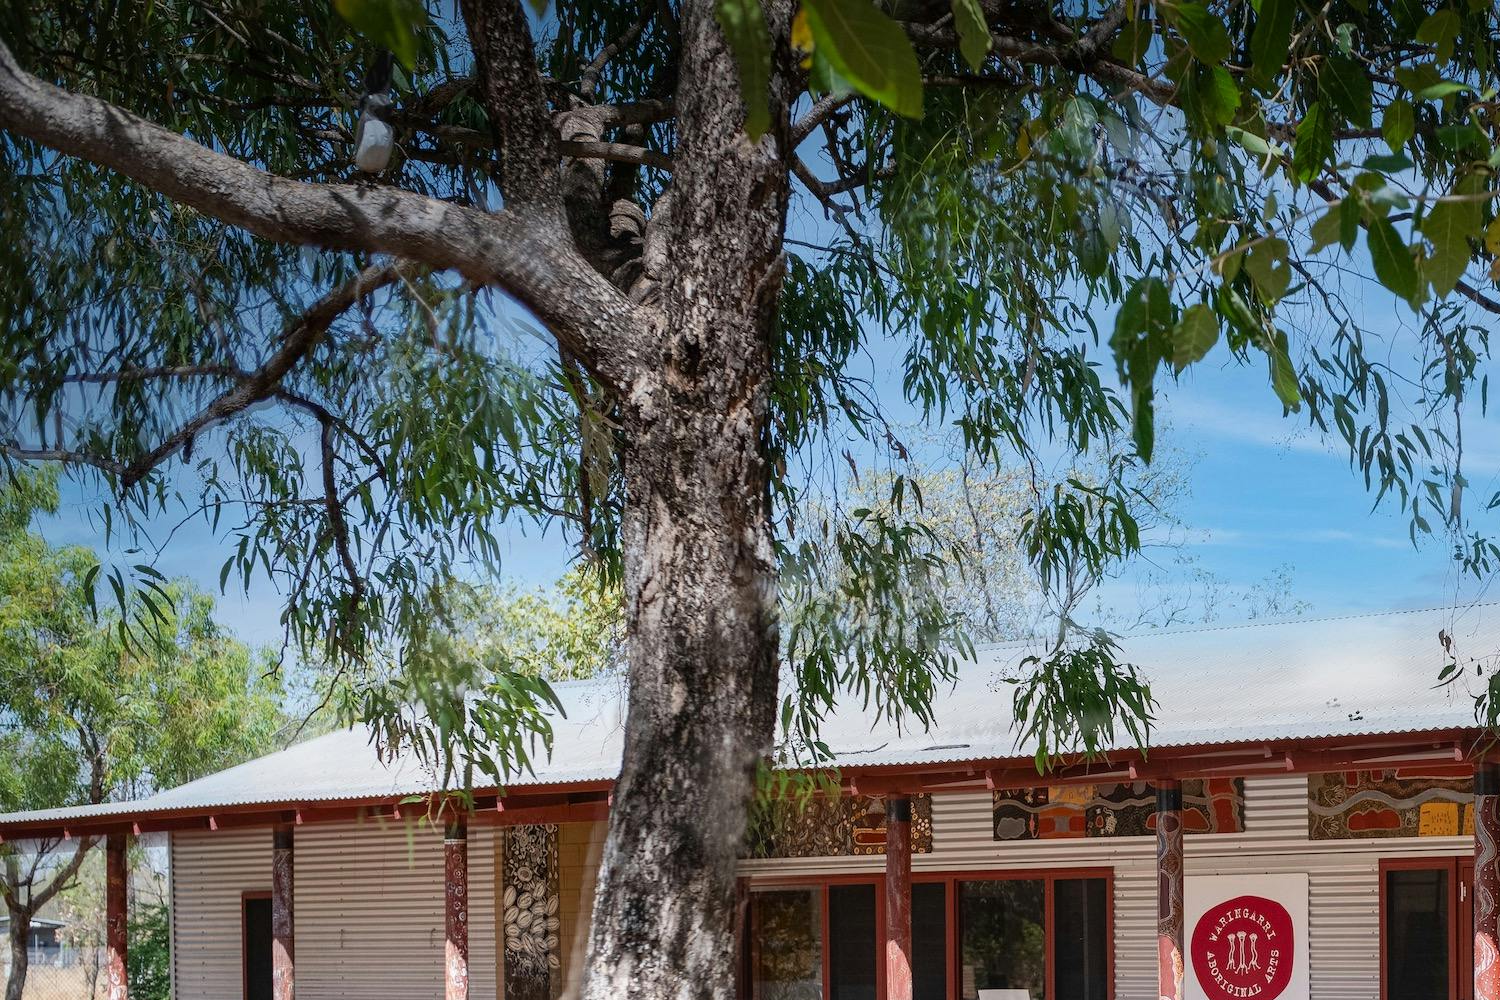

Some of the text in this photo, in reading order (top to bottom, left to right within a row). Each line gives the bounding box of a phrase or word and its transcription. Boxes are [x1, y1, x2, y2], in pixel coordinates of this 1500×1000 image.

[1209, 908, 1276, 942] WARINGARRI
[1207, 949, 1279, 998] ABORIGINAL ARTS
